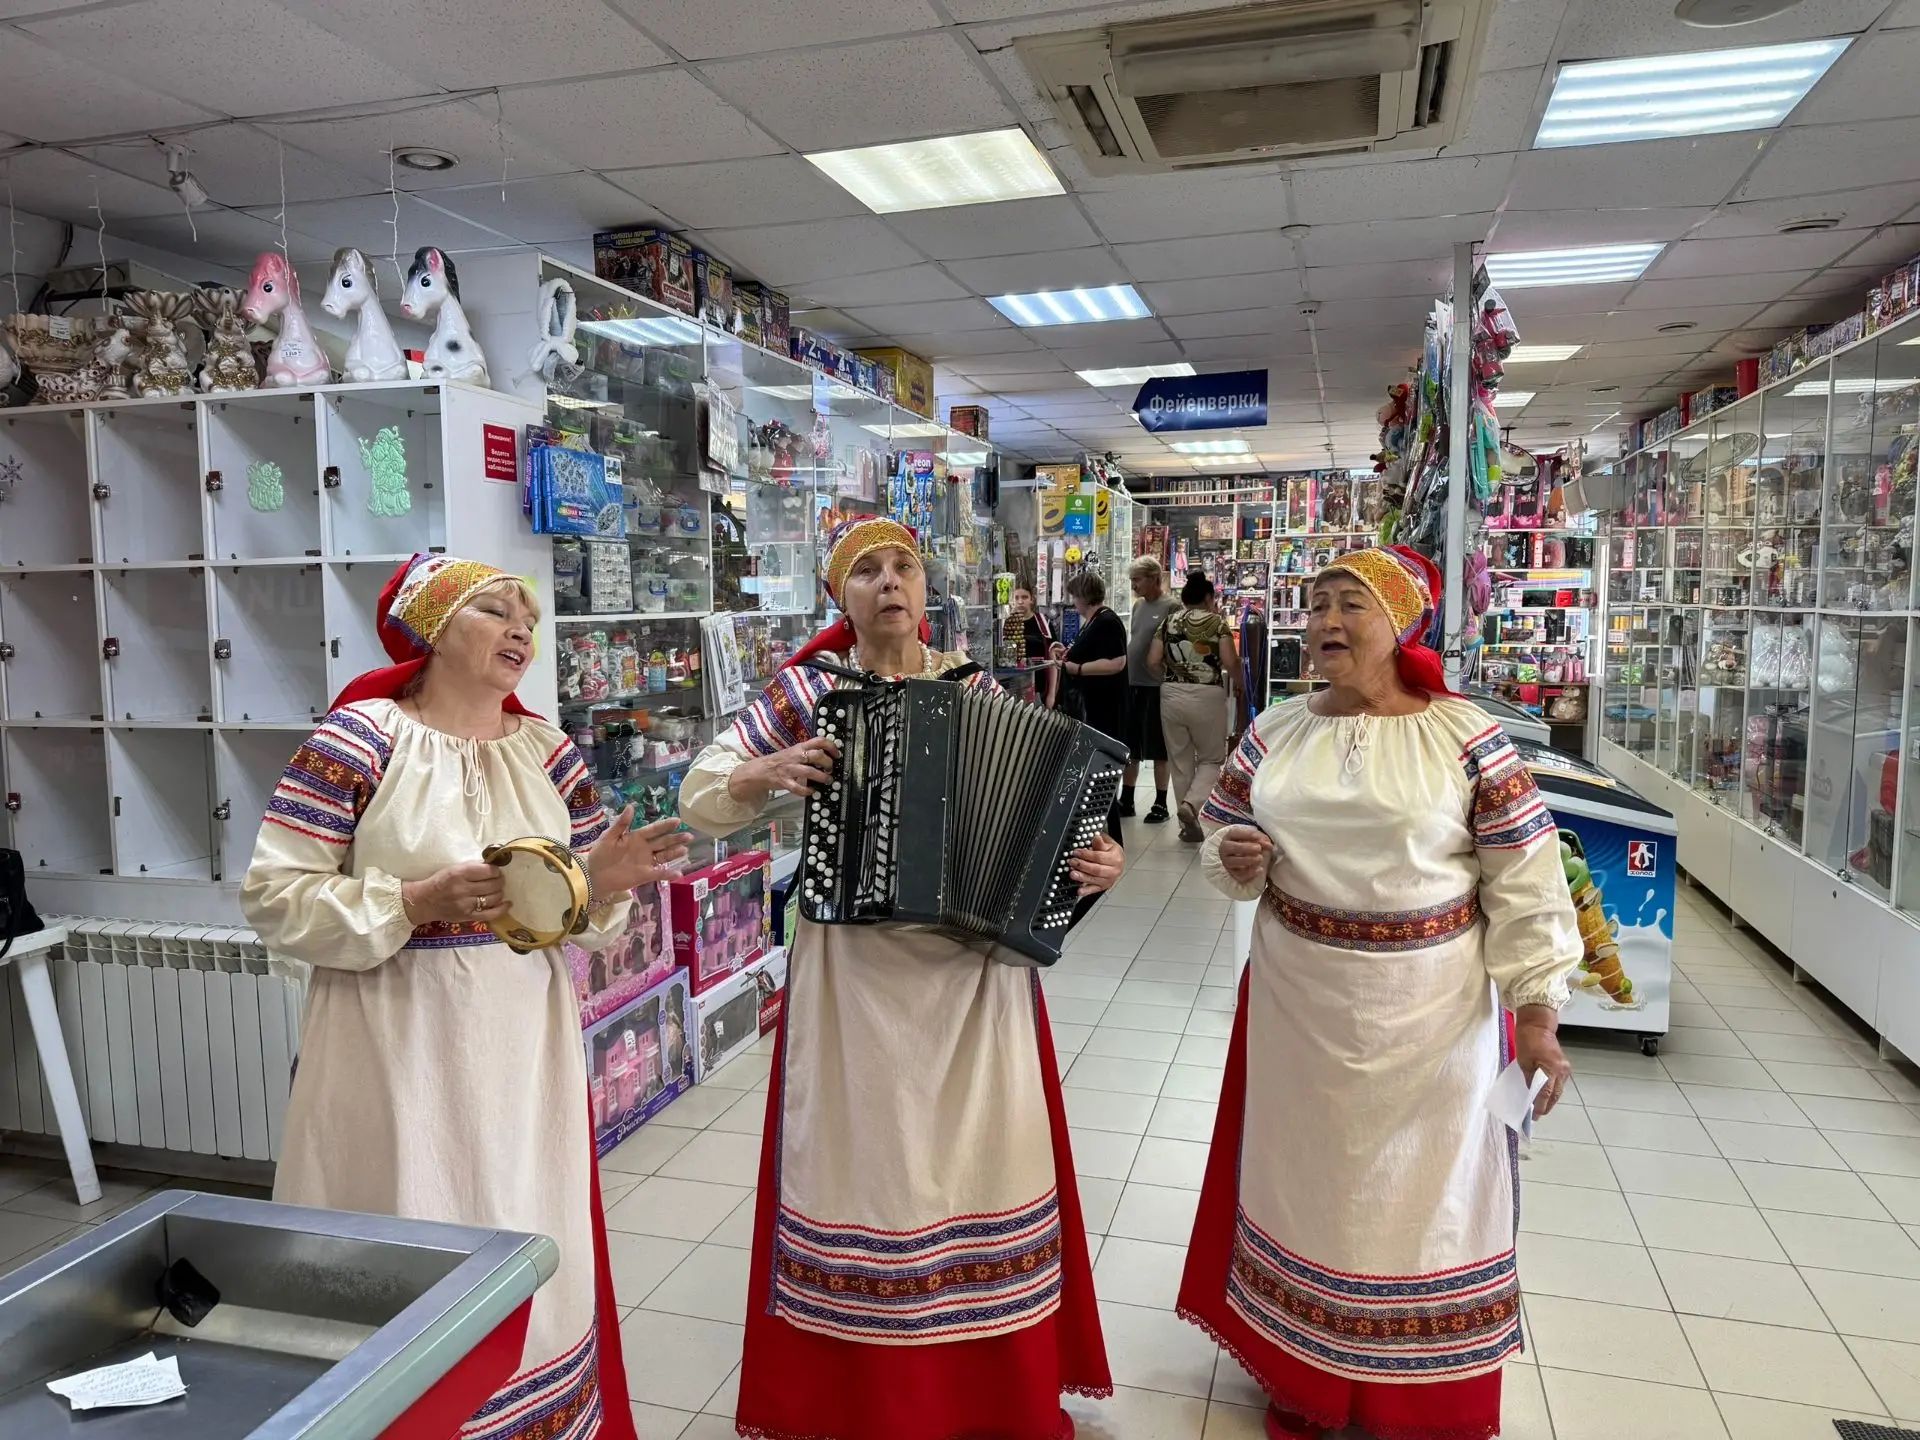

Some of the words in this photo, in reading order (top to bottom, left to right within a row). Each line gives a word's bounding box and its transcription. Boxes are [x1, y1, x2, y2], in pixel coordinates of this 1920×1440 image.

[1149, 392, 1260, 417] Фейерверки
[488, 432, 512, 442] Внимание!
[913, 458, 931, 468] reon
